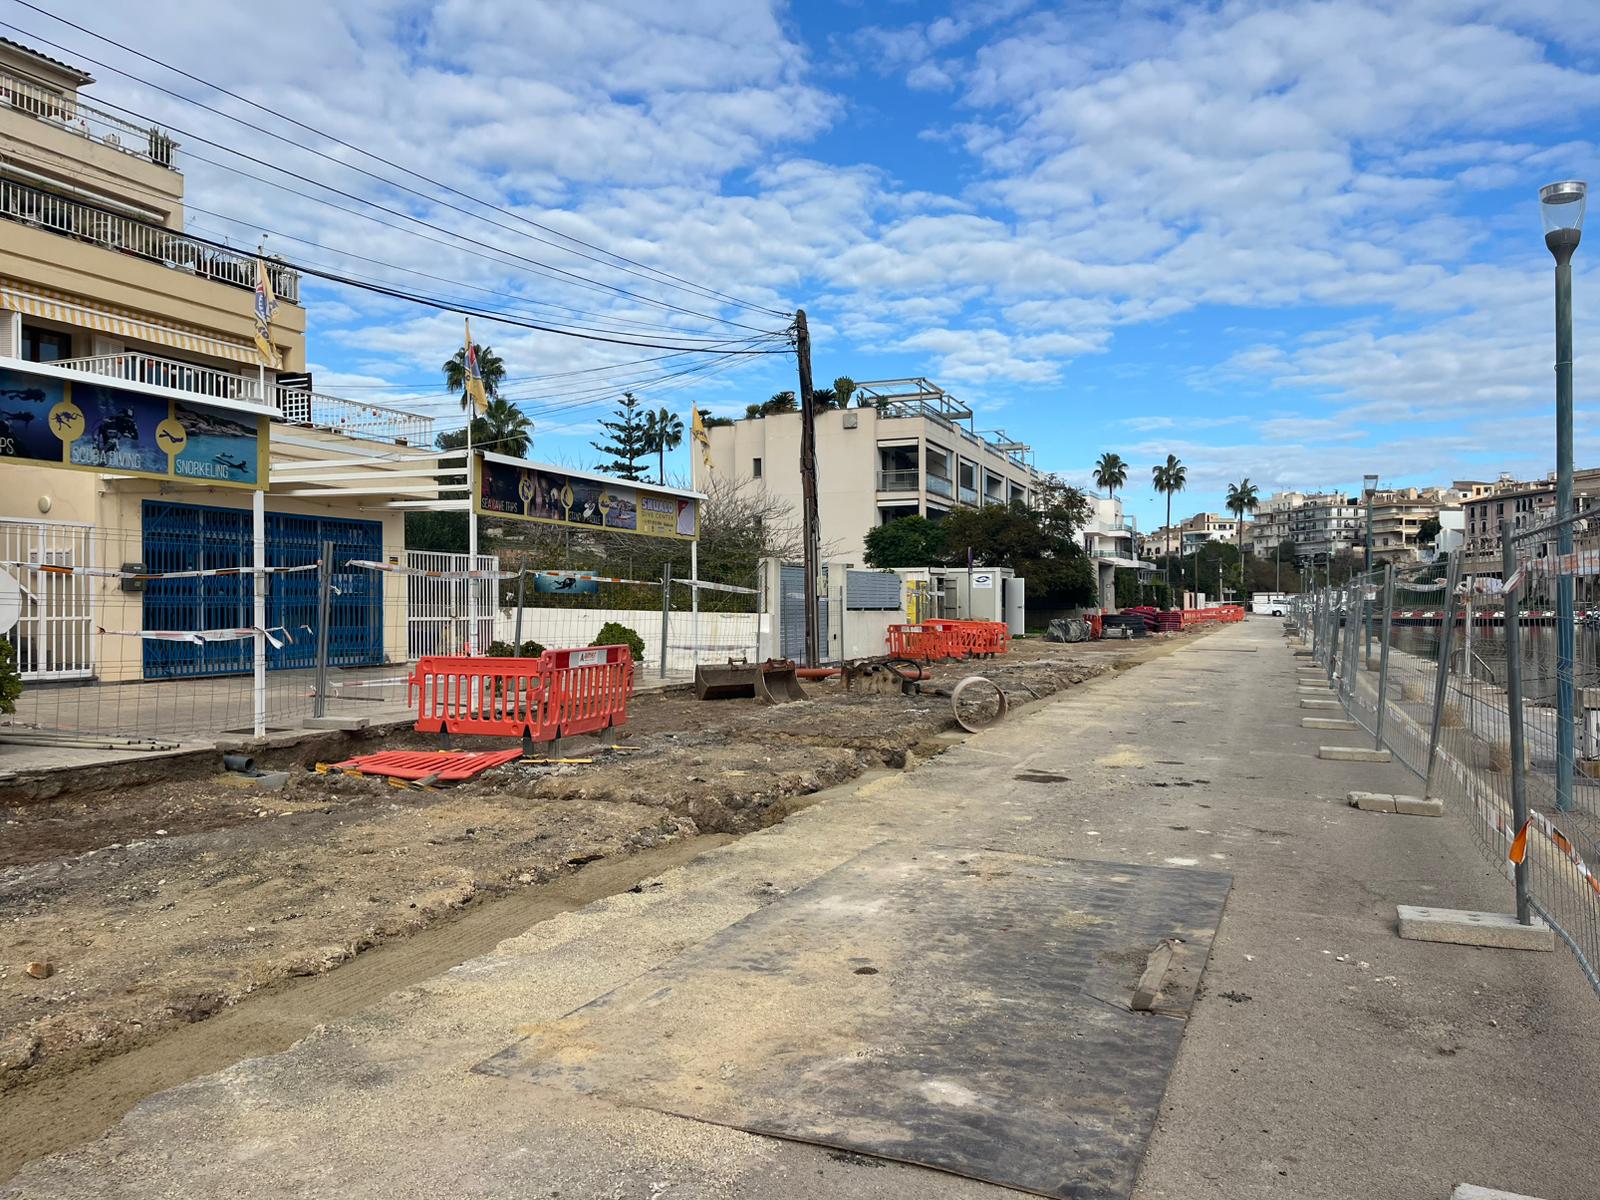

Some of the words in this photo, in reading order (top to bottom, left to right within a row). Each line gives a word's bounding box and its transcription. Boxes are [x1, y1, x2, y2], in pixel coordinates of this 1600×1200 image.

[72, 446, 107, 465] SCUBA
[109, 451, 142, 468] DIVING
[175, 458, 229, 478] SNORKELING
